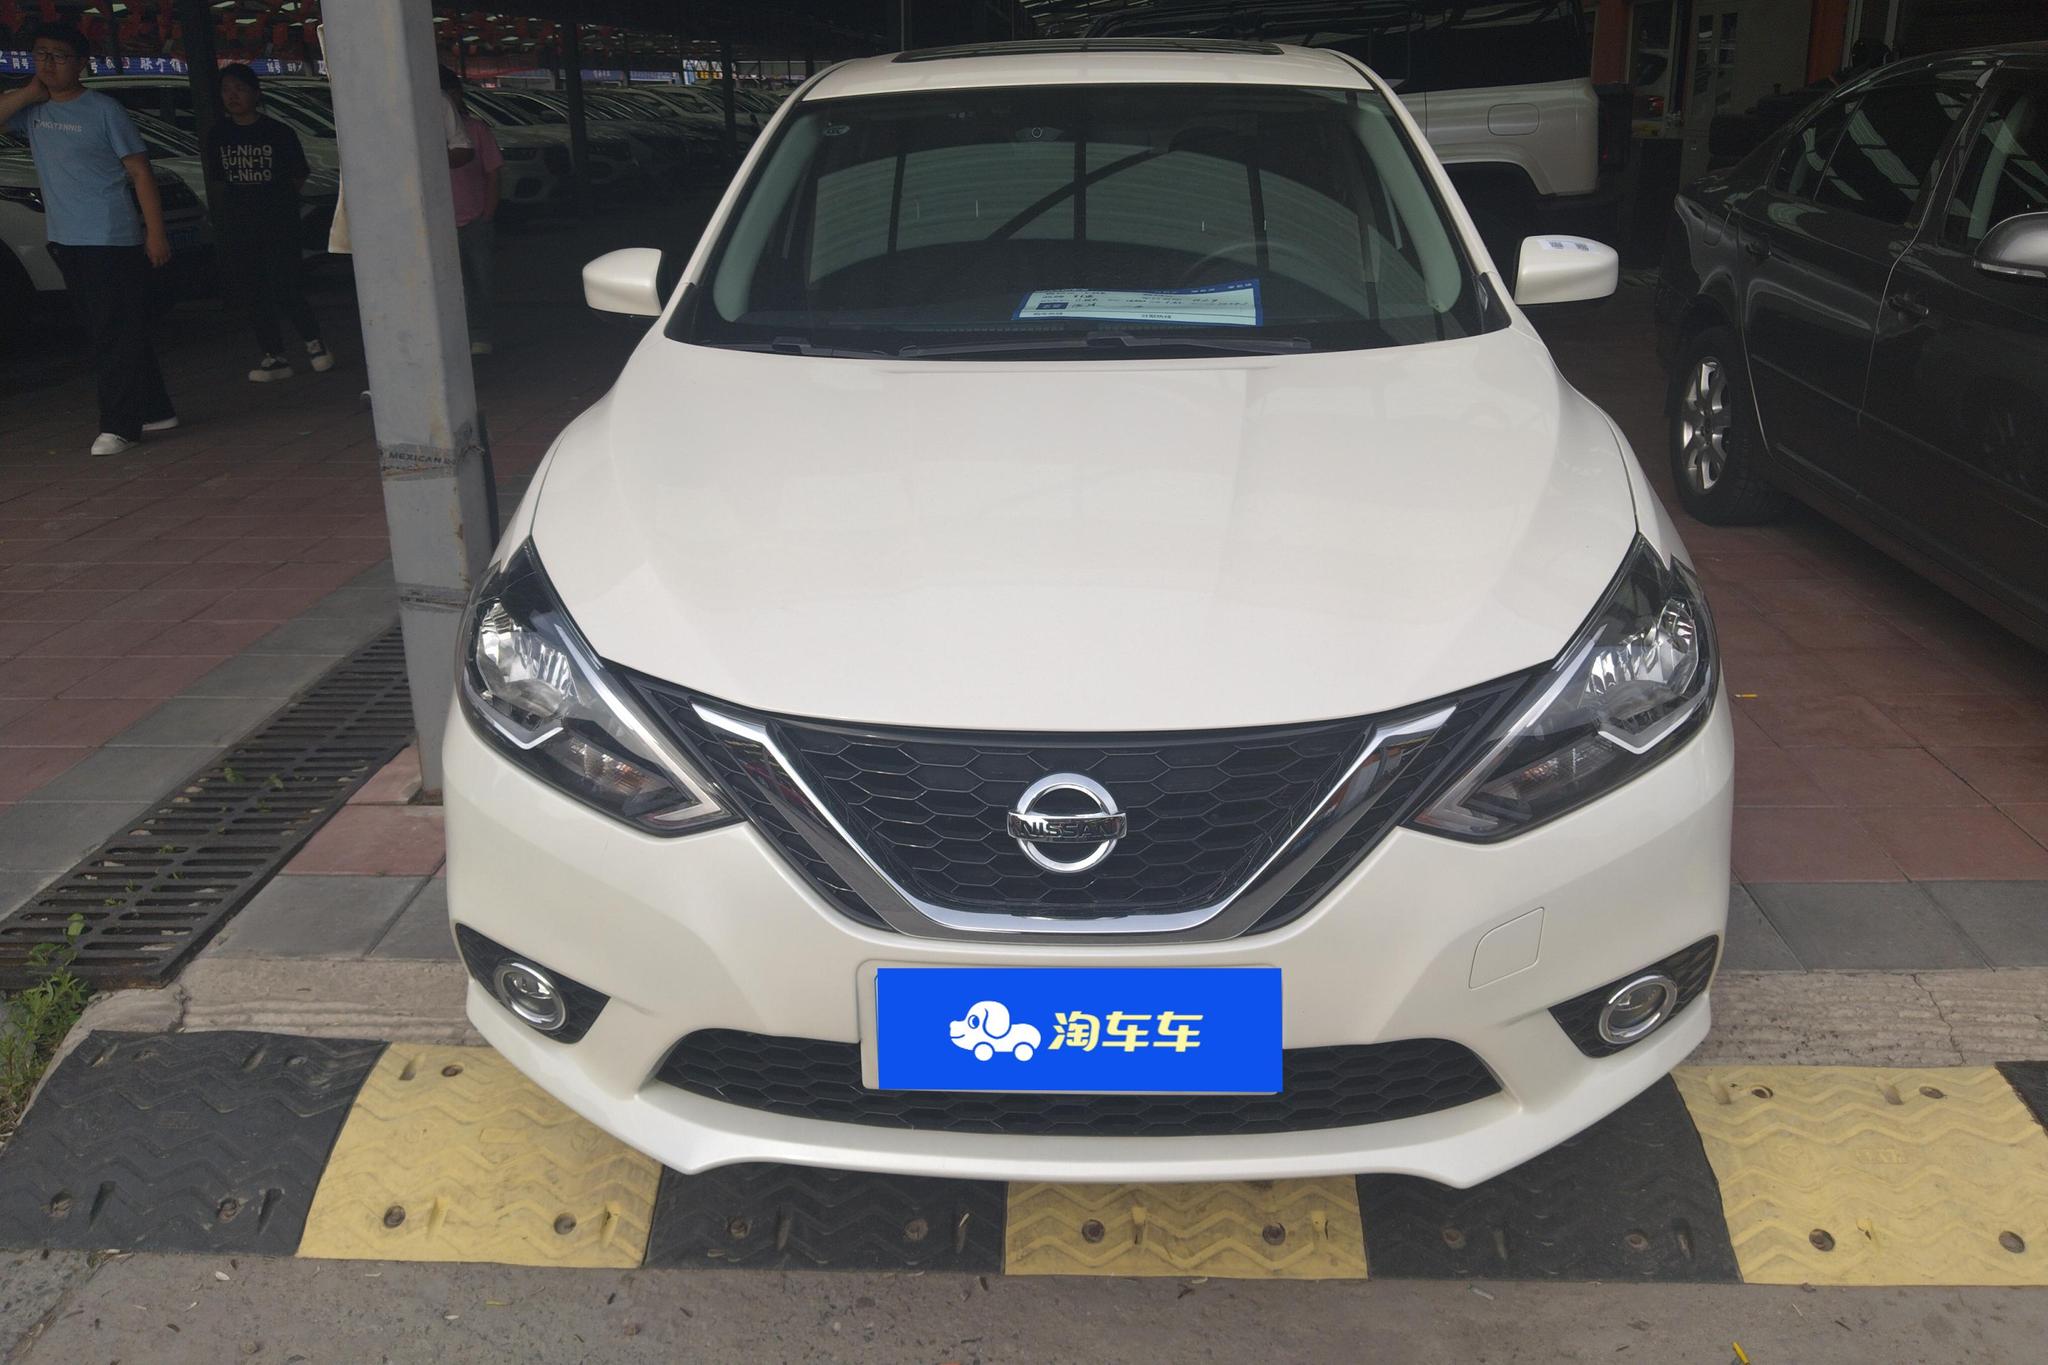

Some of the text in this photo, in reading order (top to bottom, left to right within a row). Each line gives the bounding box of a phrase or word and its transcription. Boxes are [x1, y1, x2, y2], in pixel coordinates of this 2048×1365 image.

[220, 144, 272, 156] Li-Ning
[226, 169, 272, 182] i-Ning
[1018, 820, 1118, 838] NISSAN
